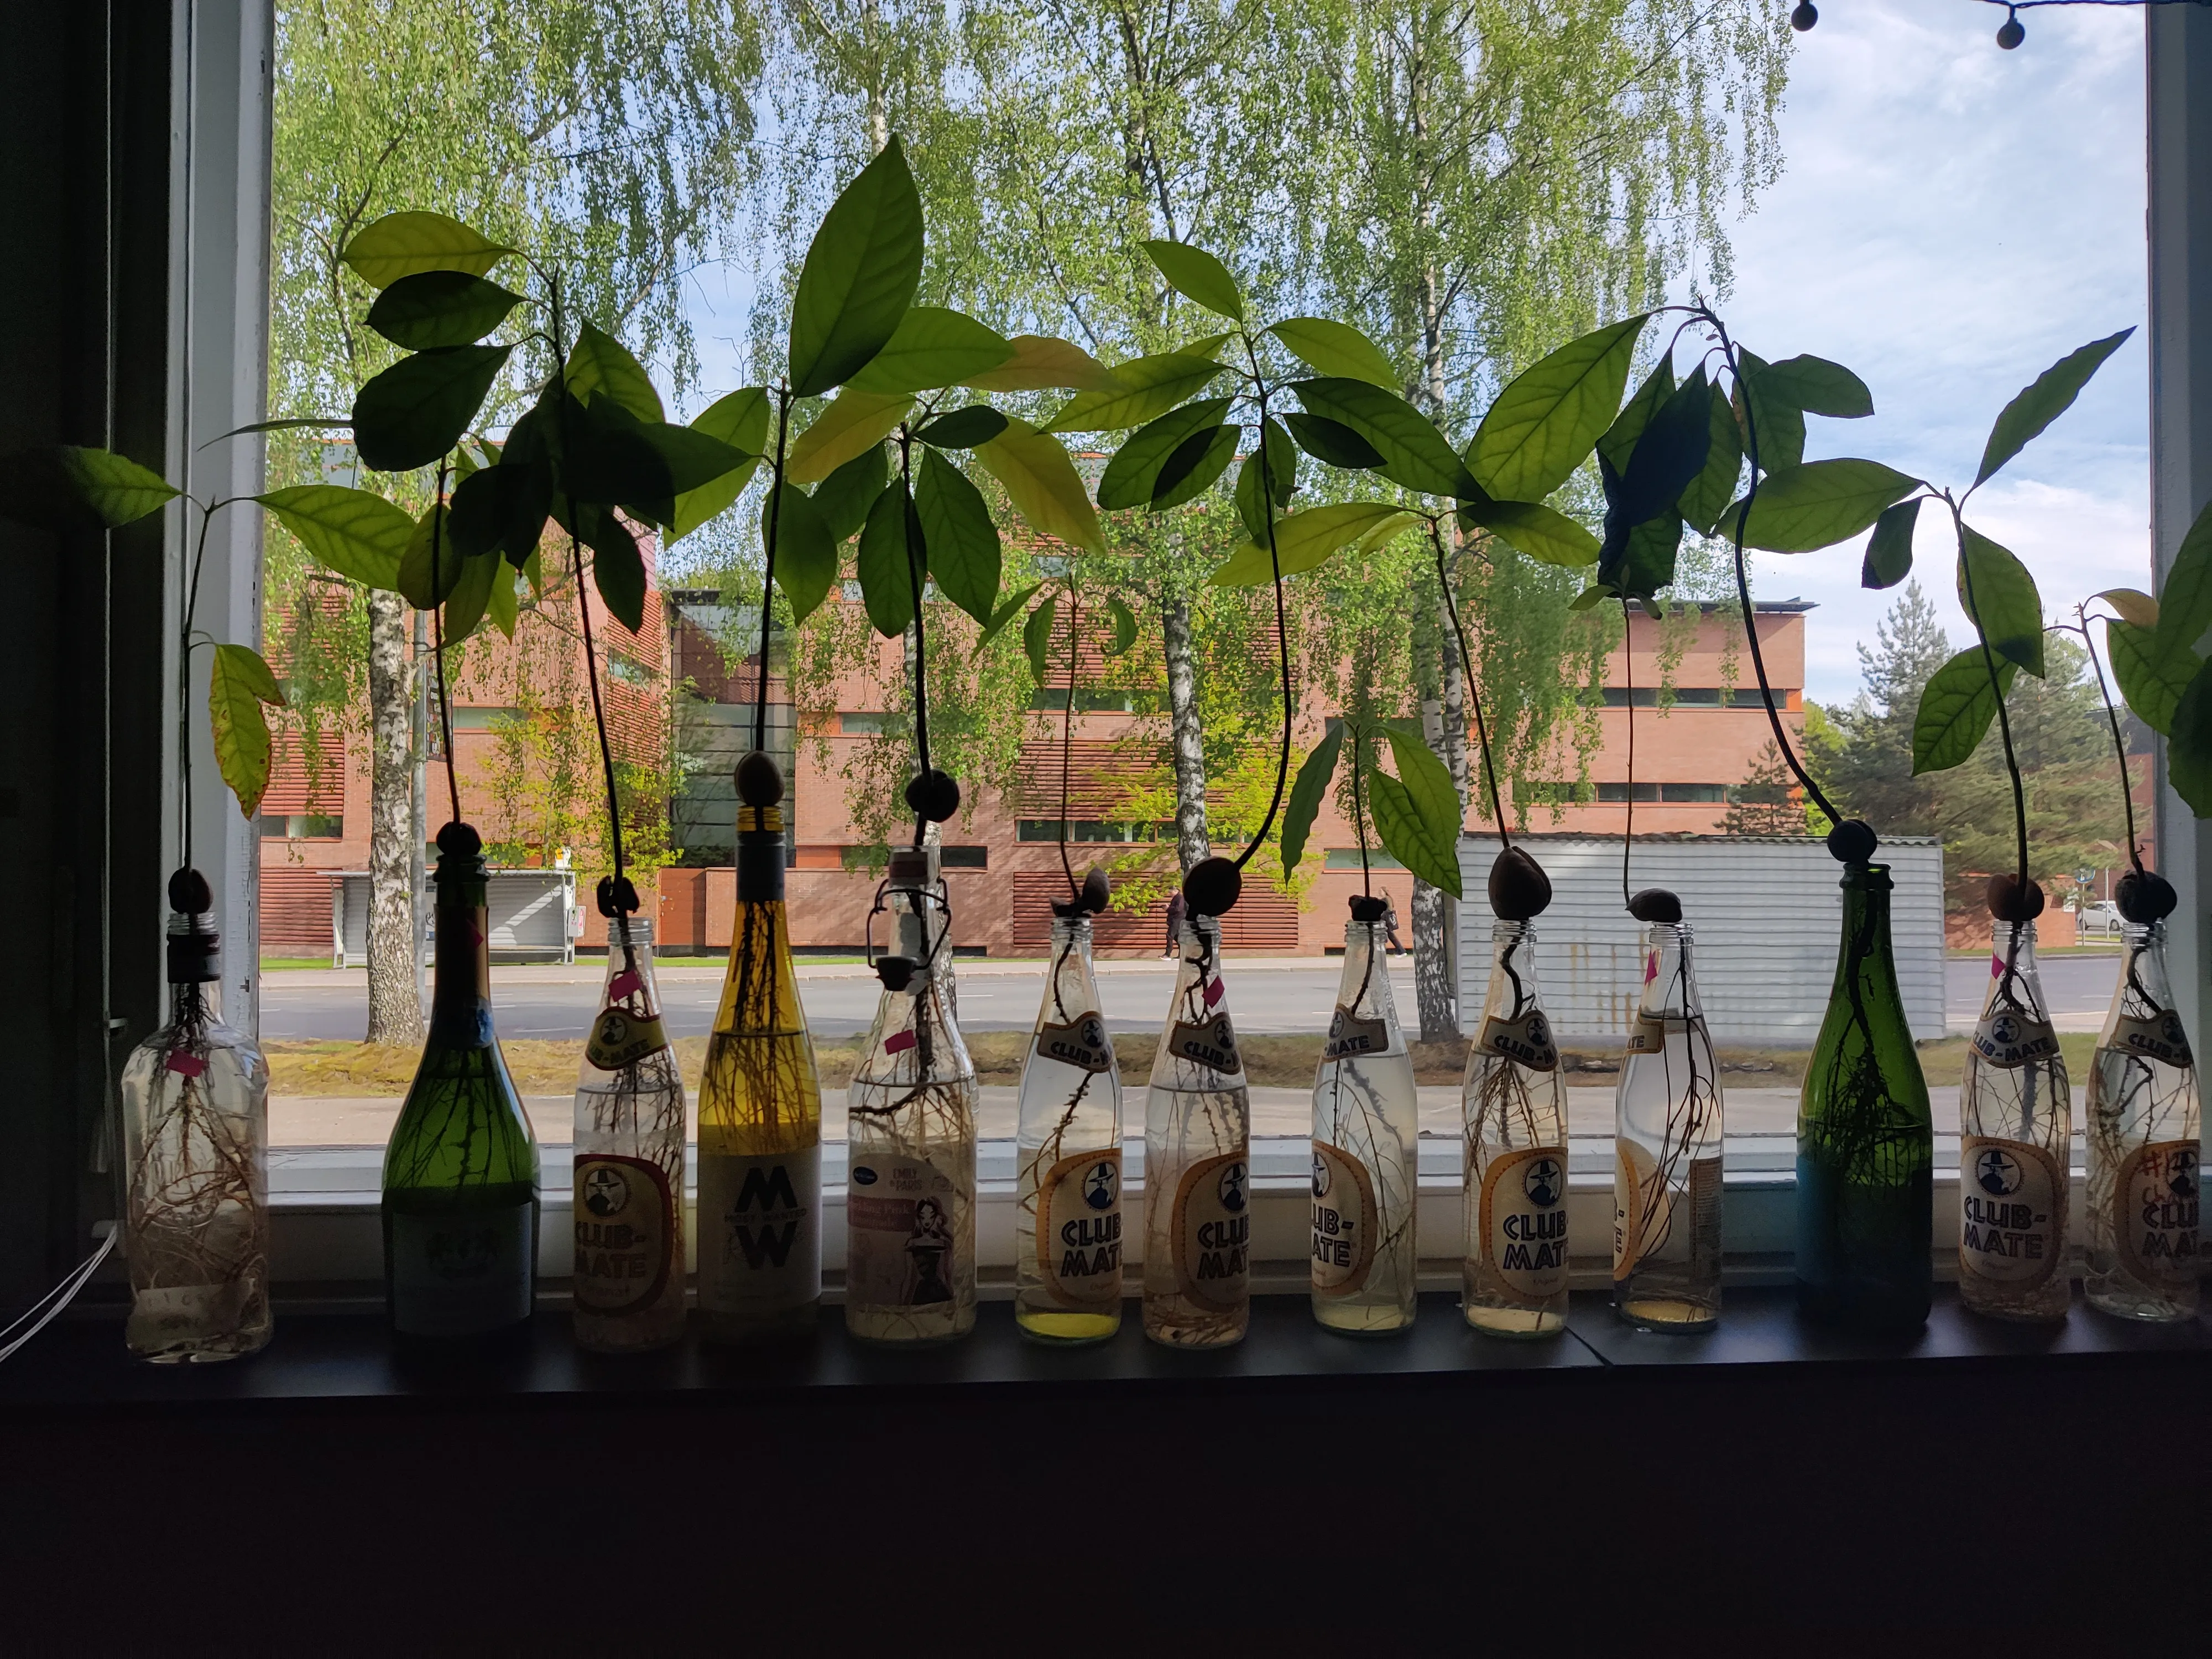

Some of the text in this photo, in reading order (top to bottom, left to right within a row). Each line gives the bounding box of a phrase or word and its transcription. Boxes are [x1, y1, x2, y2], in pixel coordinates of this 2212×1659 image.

[735, 1166, 797, 1213] M
[1964, 1196, 2046, 1230] CLUB-
[2142, 1204, 2199, 1230] CLU
[1964, 1222, 2043, 1259] MATE
